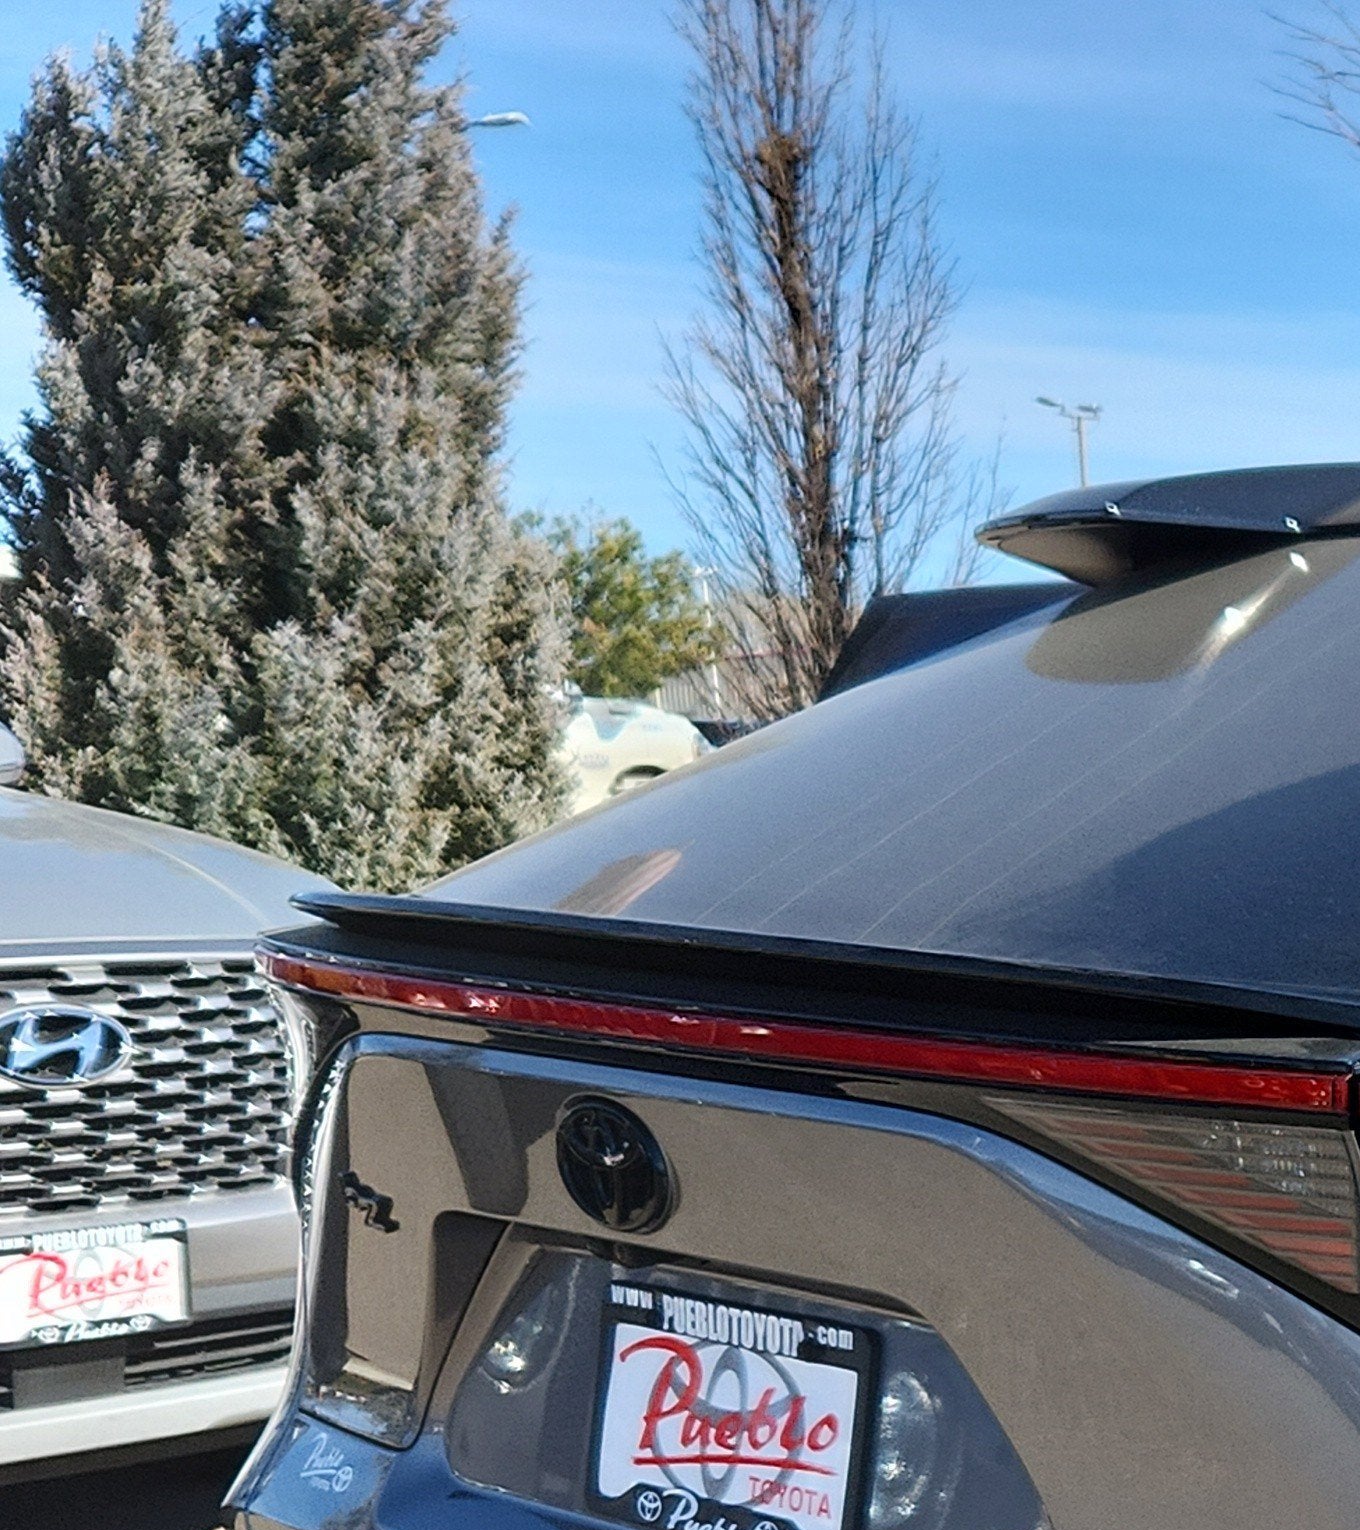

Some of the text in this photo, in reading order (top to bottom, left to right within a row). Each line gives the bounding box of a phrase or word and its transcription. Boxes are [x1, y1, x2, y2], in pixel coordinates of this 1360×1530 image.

[0, 1252, 169, 1310] Pueblo
[662, 1293, 805, 1358] PUEBLOTOYOTA
[618, 1335, 840, 1451] Pueblo
[748, 1475, 832, 1519] TOYOTA
